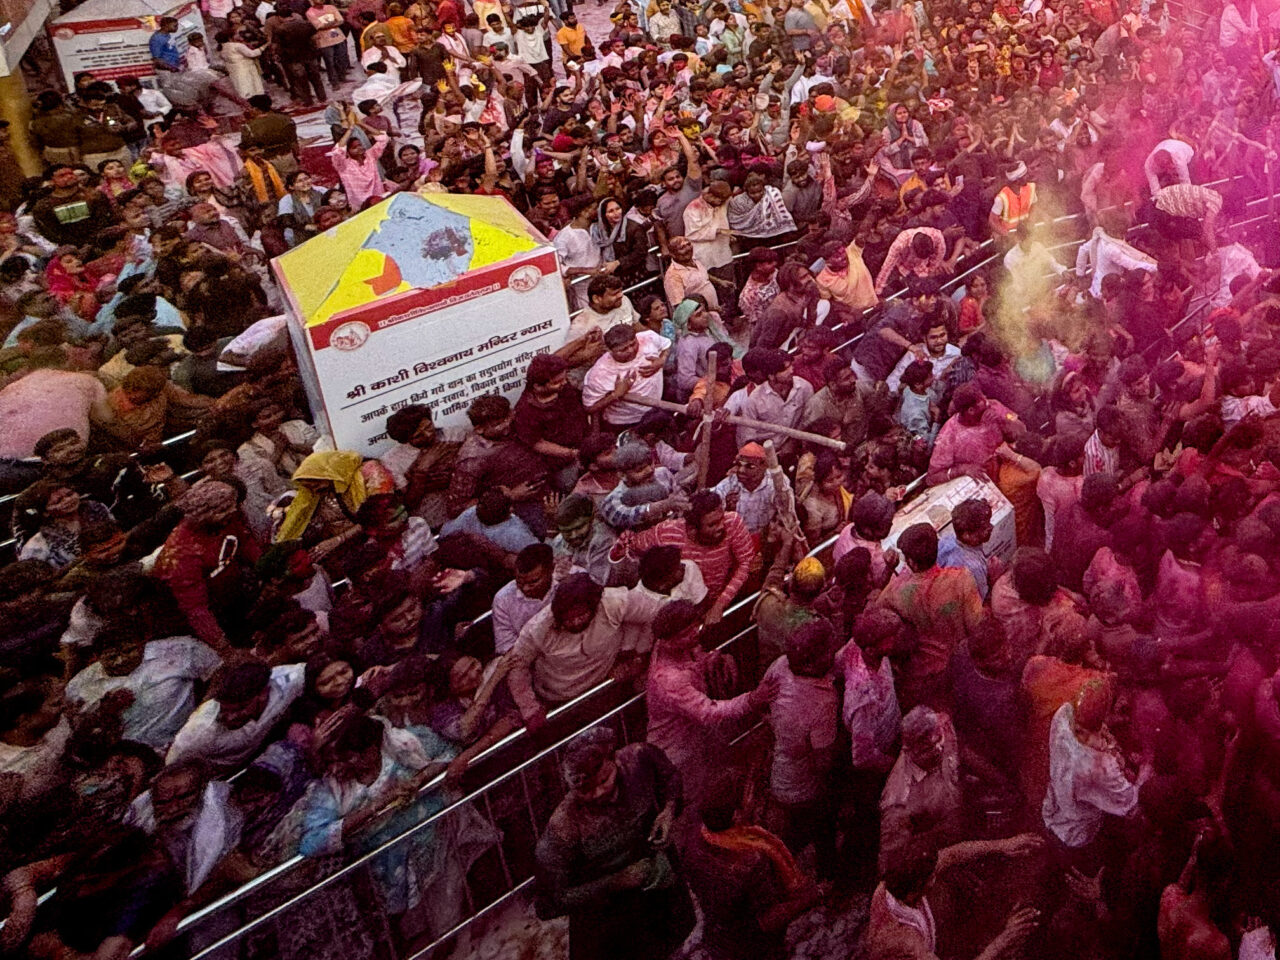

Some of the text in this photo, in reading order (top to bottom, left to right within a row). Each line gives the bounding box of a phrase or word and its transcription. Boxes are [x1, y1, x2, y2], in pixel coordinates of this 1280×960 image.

[345, 319, 553, 400] श्री काशी विश्वनाथ मन्दिर न्यास
[361, 405, 388, 422] आपके
[448, 378, 464, 389] दान
[466, 373, 476, 383] का
